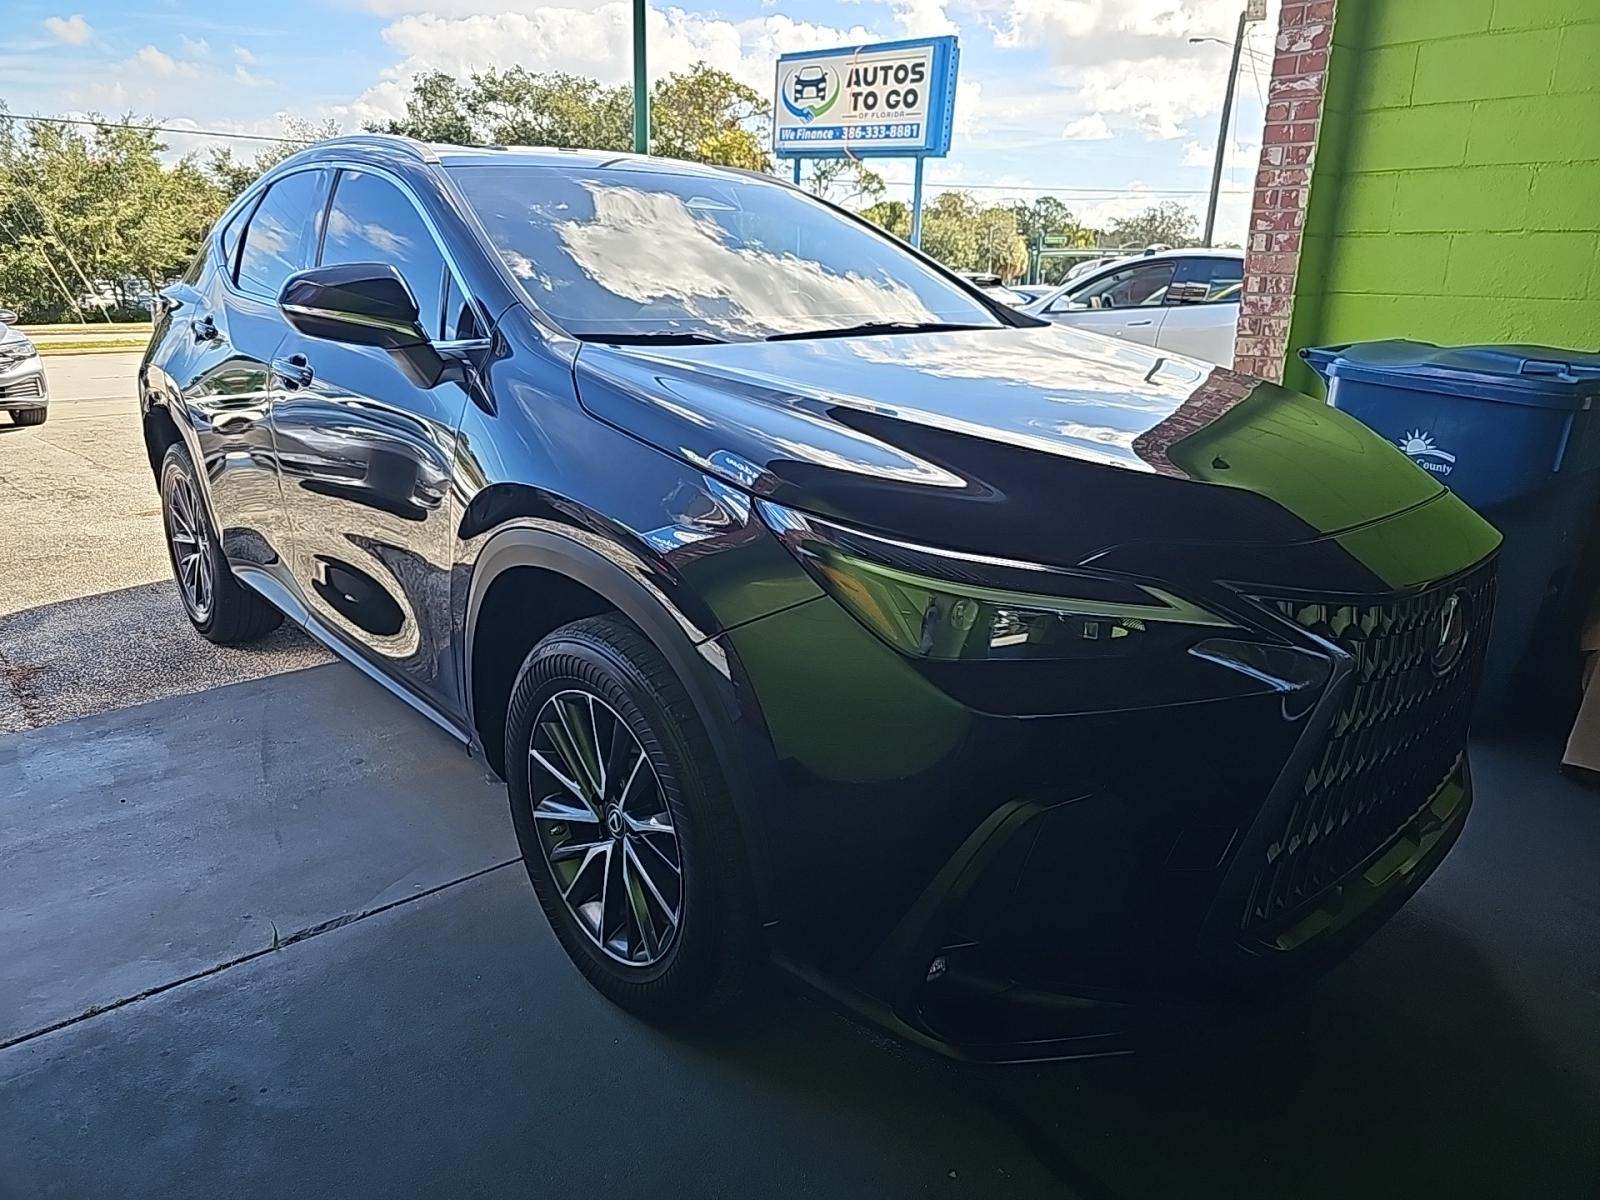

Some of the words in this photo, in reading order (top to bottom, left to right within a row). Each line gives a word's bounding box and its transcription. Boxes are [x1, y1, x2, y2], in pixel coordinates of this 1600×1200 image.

[846, 62, 925, 88] AUTOS
[852, 91, 878, 111] TO
[886, 88, 918, 110] GO
[871, 111, 904, 119] FLORIDA
[781, 129, 794, 140] We
[797, 127, 834, 140] Finance
[841, 124, 917, 140] 386-333-8881
